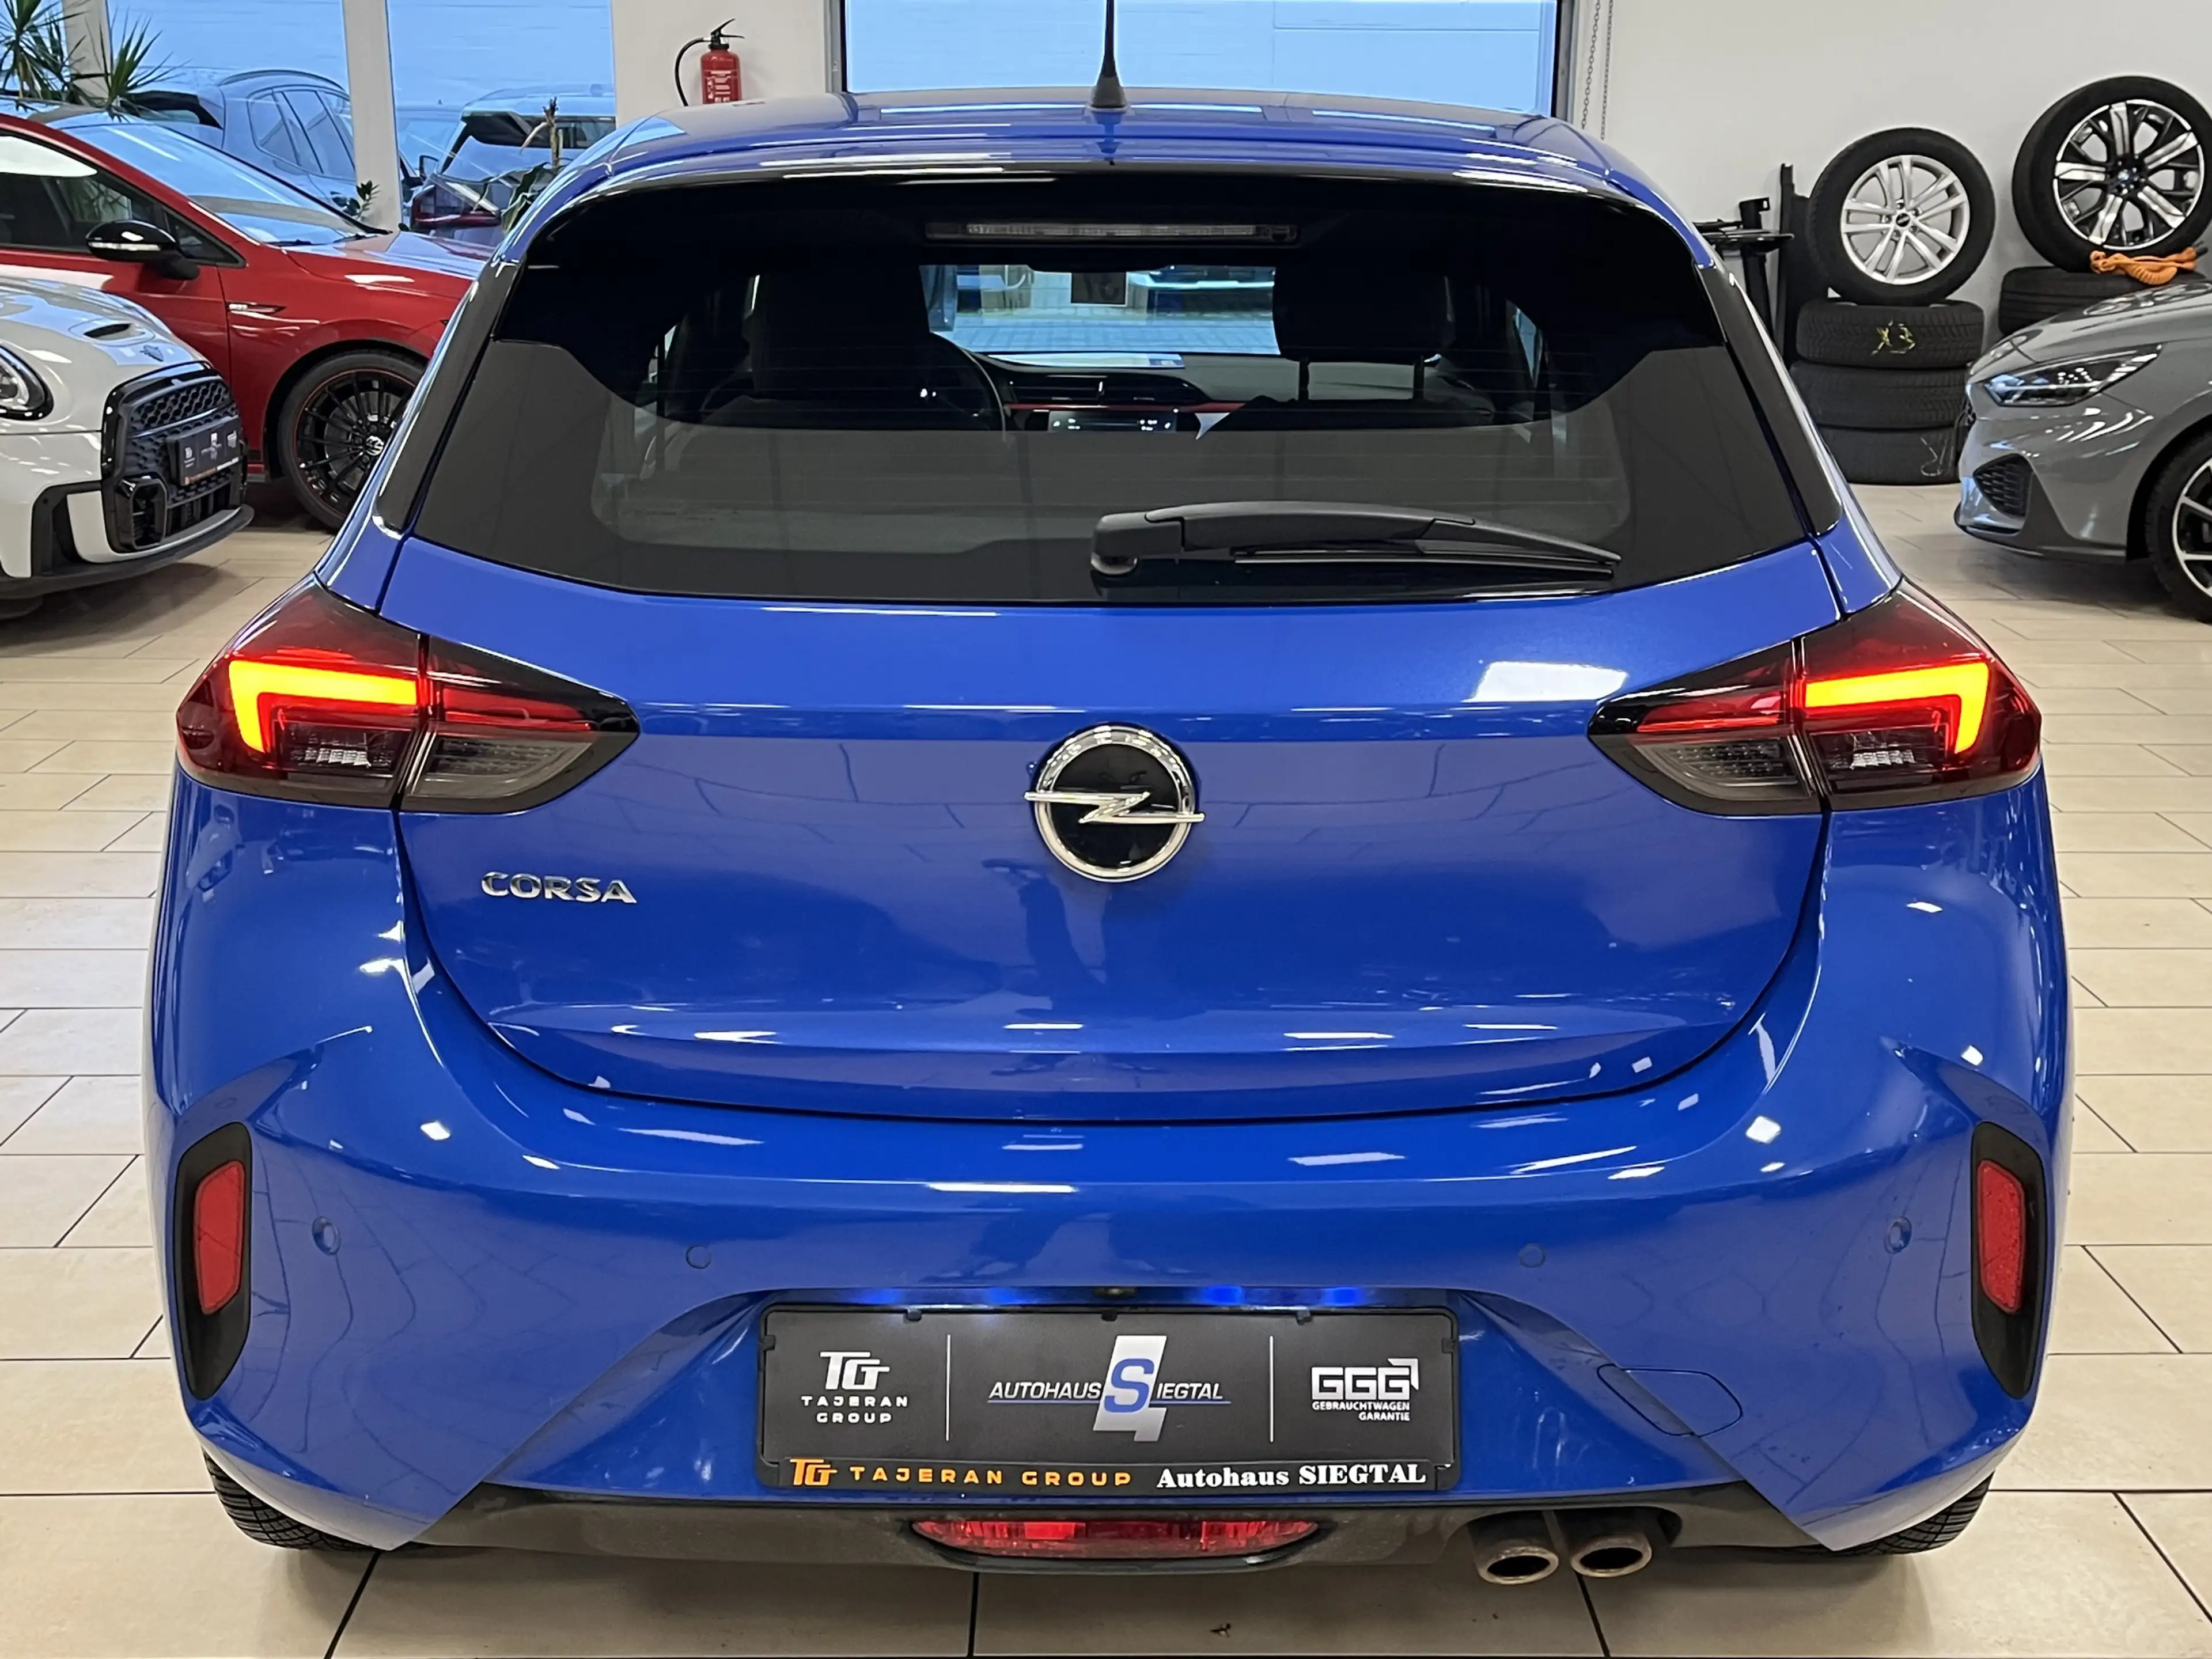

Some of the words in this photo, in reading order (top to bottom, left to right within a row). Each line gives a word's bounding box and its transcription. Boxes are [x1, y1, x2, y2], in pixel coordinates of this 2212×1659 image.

[482, 872, 637, 903] CORSA
[820, 1351, 890, 1390] TG
[989, 1382, 1101, 1399] AUTOHAUS
[1312, 1367, 1410, 1400] GGG
[801, 1396, 908, 1407] TAJERAN
[1312, 1401, 1410, 1411] GEBRAUCHTWAGEN
[816, 1412, 892, 1423] GROUP
[1358, 1412, 1410, 1421] GARANTIE
[790, 1459, 838, 1486] TG
[850, 1467, 1002, 1484] TAJERAN
[1021, 1471, 1131, 1486] GROUP
[1156, 1467, 1290, 1488] Autohaus
[1298, 1464, 1426, 1485] SIEGTAL
